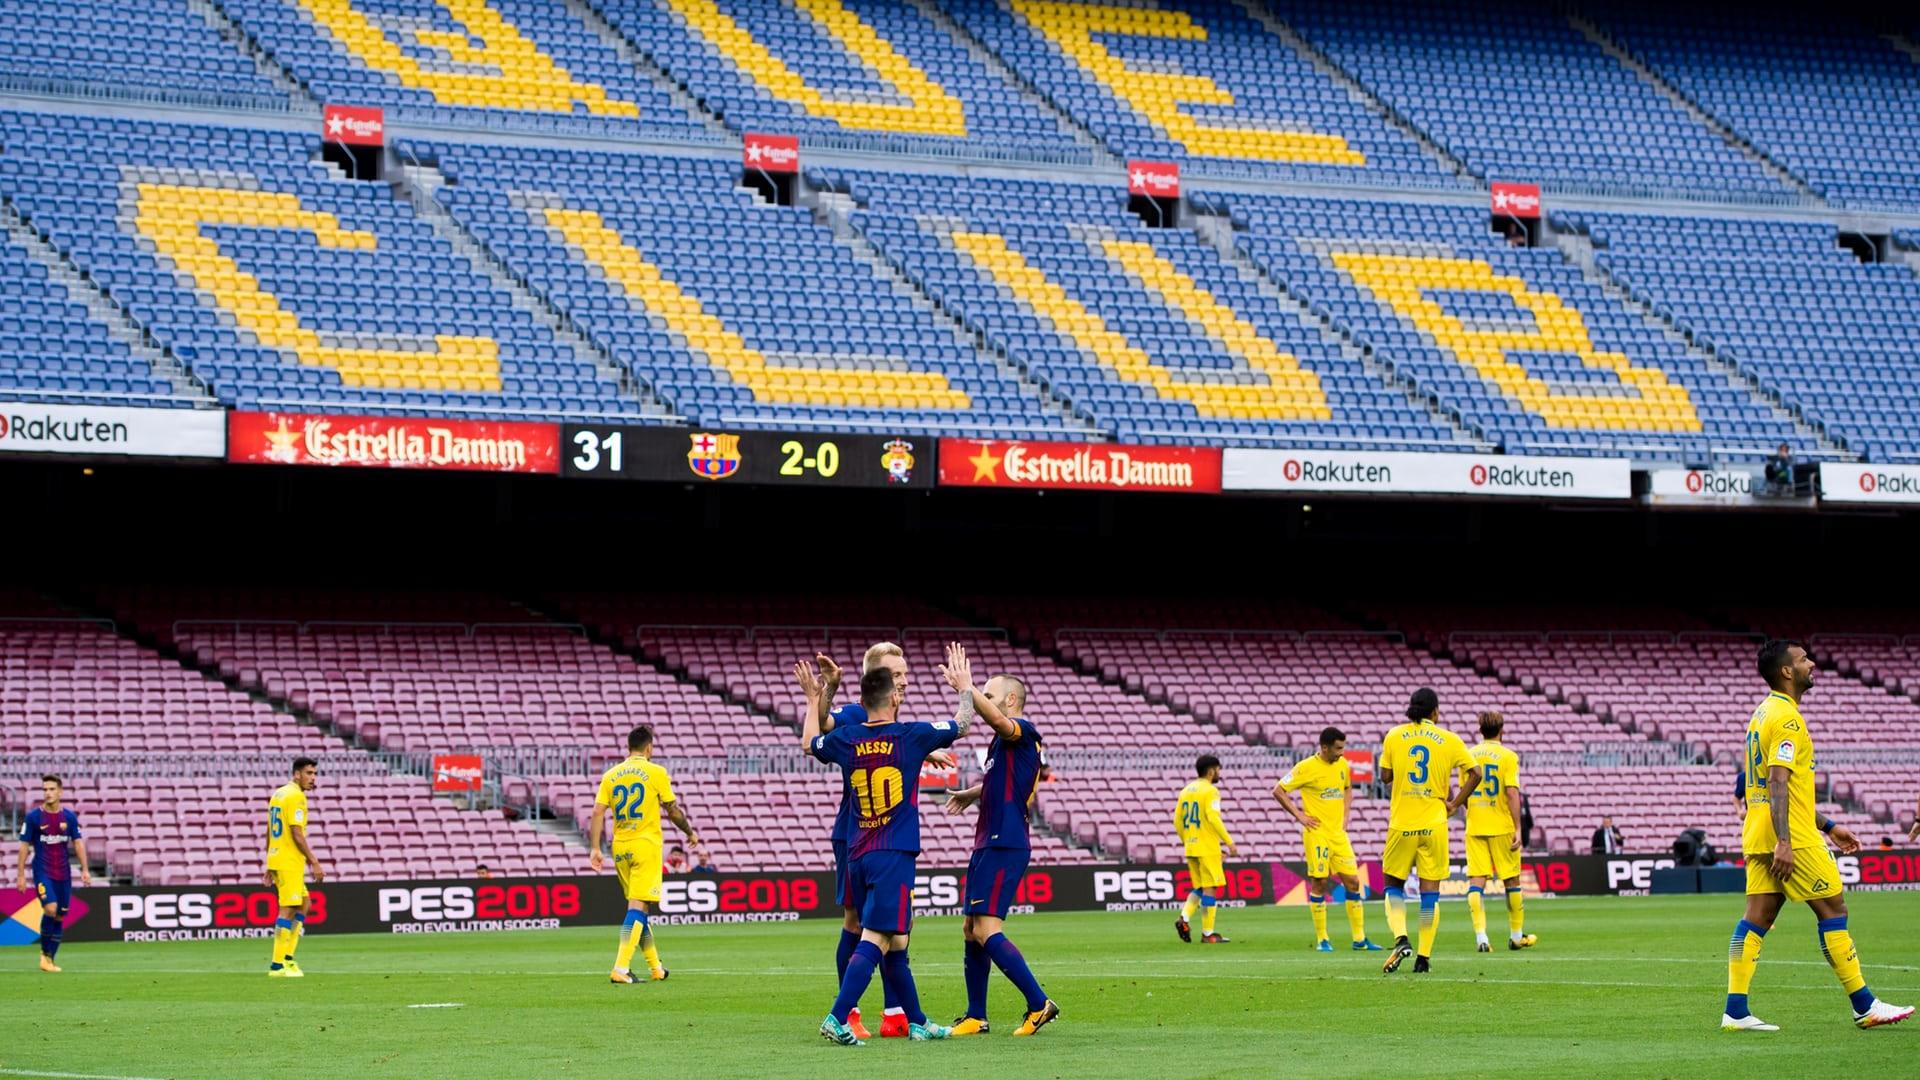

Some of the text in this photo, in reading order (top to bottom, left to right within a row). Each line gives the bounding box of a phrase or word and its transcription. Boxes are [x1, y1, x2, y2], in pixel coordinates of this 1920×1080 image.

[11, 415, 128, 442] Rakuten
[304, 419, 526, 467] Estrella Damm
[573, 431, 622, 471] 31
[779, 440, 839, 477] 2-0
[1003, 445, 1193, 486] Estrella Damm
[1302, 461, 1391, 482] Rakuten
[1489, 465, 1574, 487] Rakuten
[855, 741, 894, 757] MESSI
[1408, 745, 1430, 784] 3
[612, 782, 646, 820] 22
[849, 766, 904, 818] 10
[1182, 801, 1200, 830] 24
[124, 930, 158, 943] PRO
[160, 927, 242, 942] EVOLUTION
[392, 918, 561, 934] PRO EVOLUTION SOCCER
